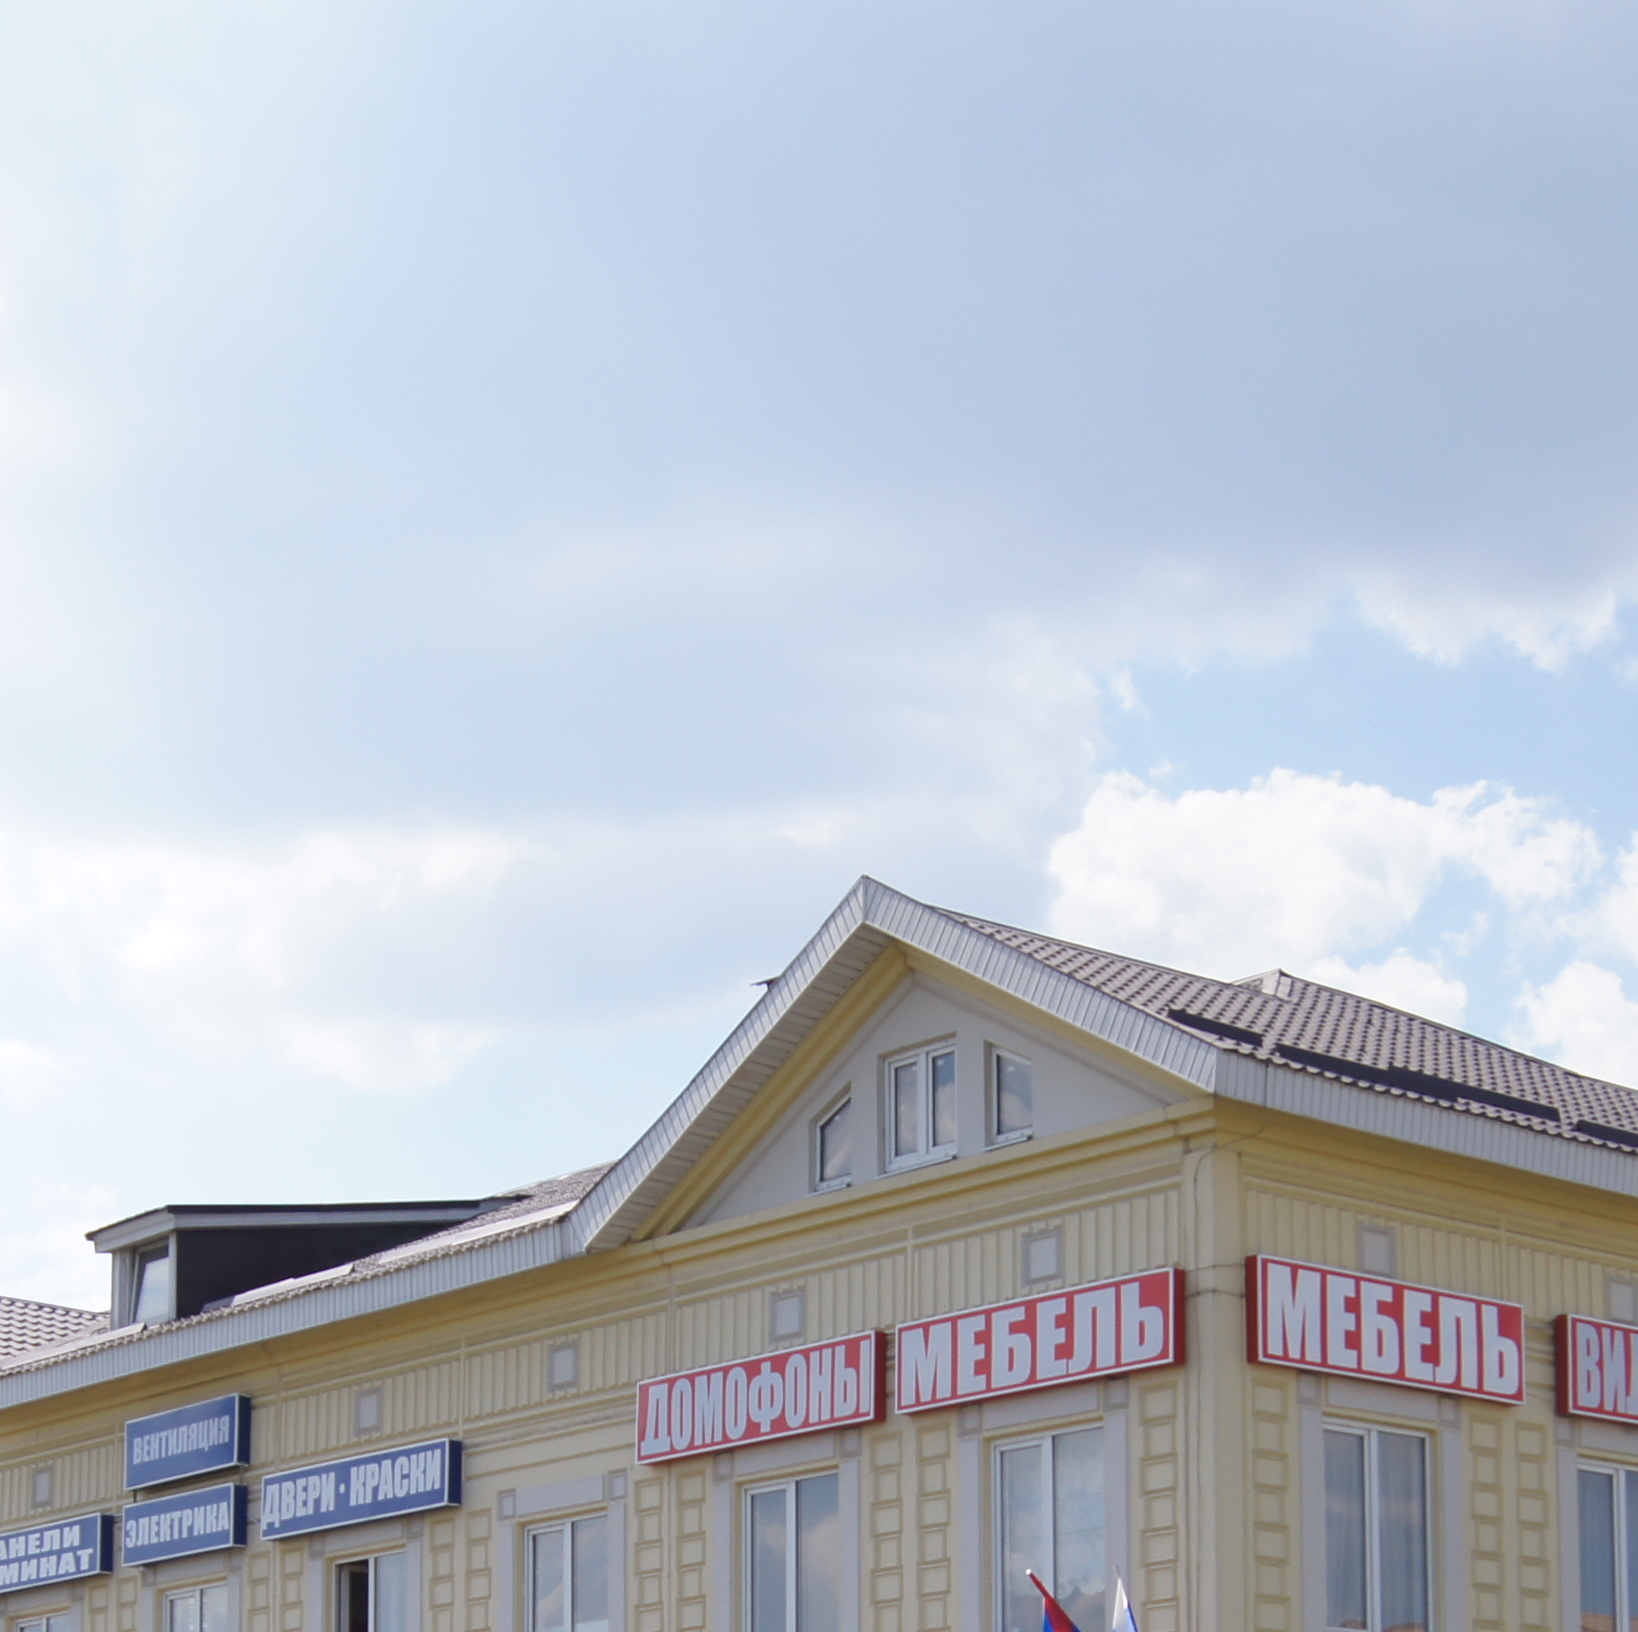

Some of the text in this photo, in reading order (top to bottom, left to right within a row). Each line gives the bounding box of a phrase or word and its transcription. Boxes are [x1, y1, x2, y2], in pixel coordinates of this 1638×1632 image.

[902, 1282, 1164, 1406] МЕБЕЛЬ
[1267, 1263, 1519, 1396] МЕБЕЛЬ
[133, 1415, 230, 1464] ВЕНТИЛЯЦИЯ
[640, 1338, 872, 1457] ДОМОФОНЫ
[126, 1501, 229, 1548] ЭЛЕКТРИКА
[263, 1449, 442, 1530] ДВЕРИ КРАСКИ
